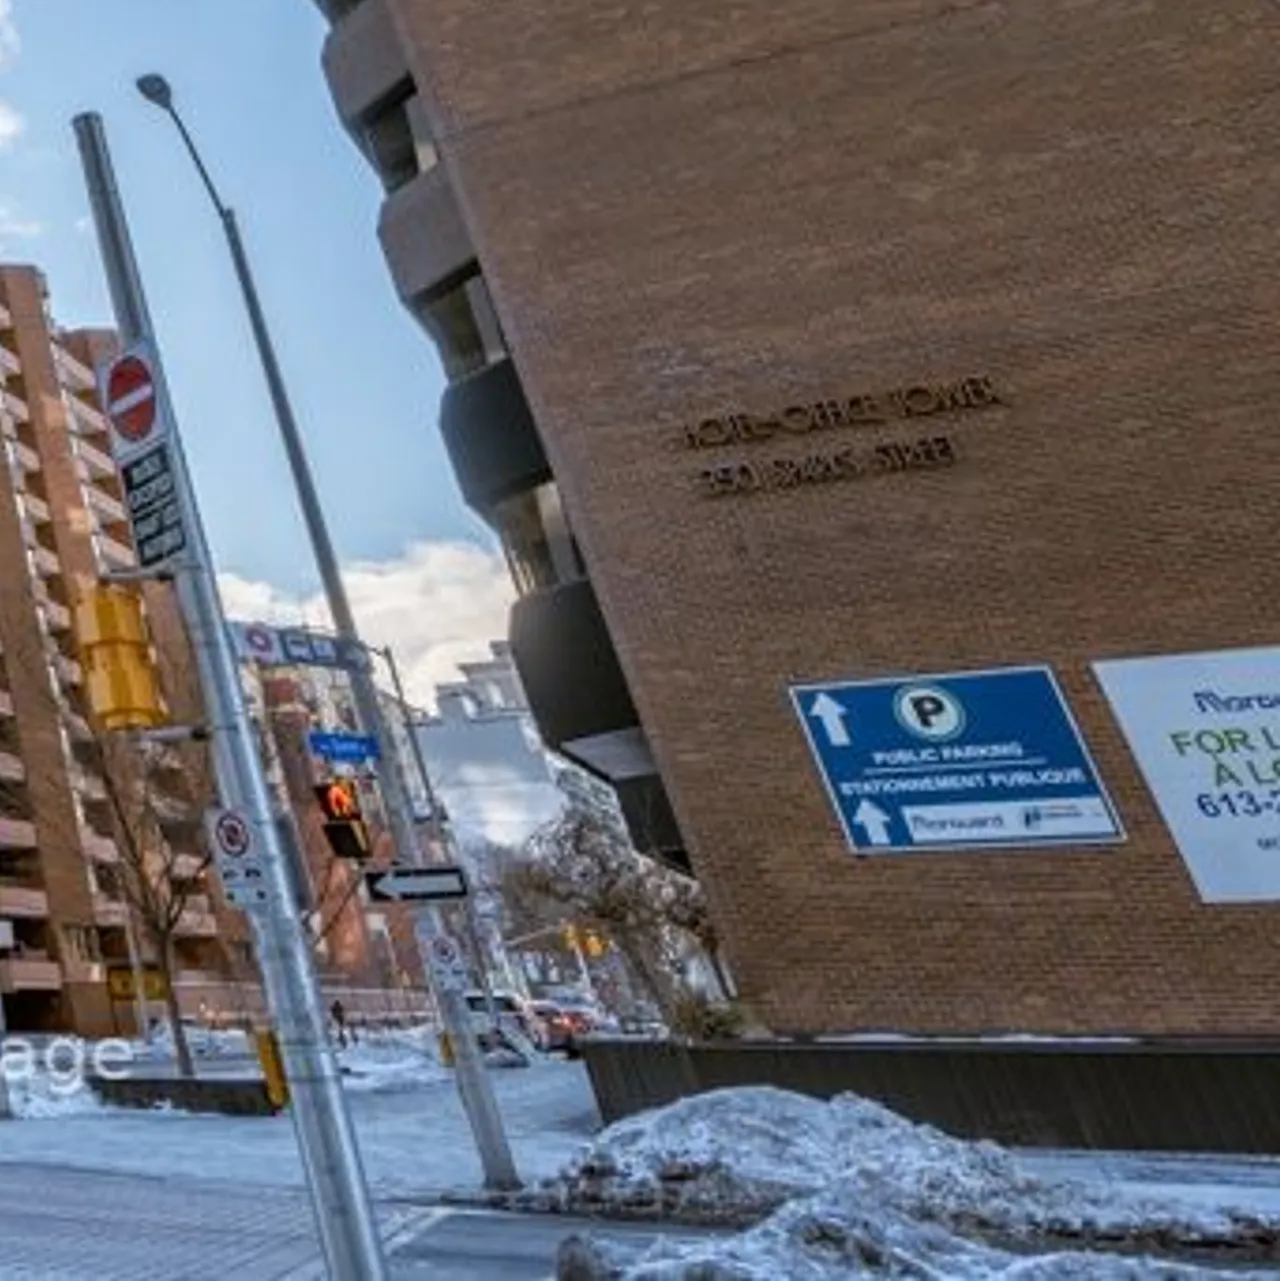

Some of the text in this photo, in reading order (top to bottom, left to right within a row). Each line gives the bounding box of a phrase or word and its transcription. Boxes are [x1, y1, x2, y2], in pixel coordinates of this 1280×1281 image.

[908, 694, 945, 727] P
[871, 740, 1023, 766] PUBLIC PARKING
[1170, 729, 1256, 756] FOR
[840, 766, 1088, 796] STATIONNEMENT PUBLIQUE
